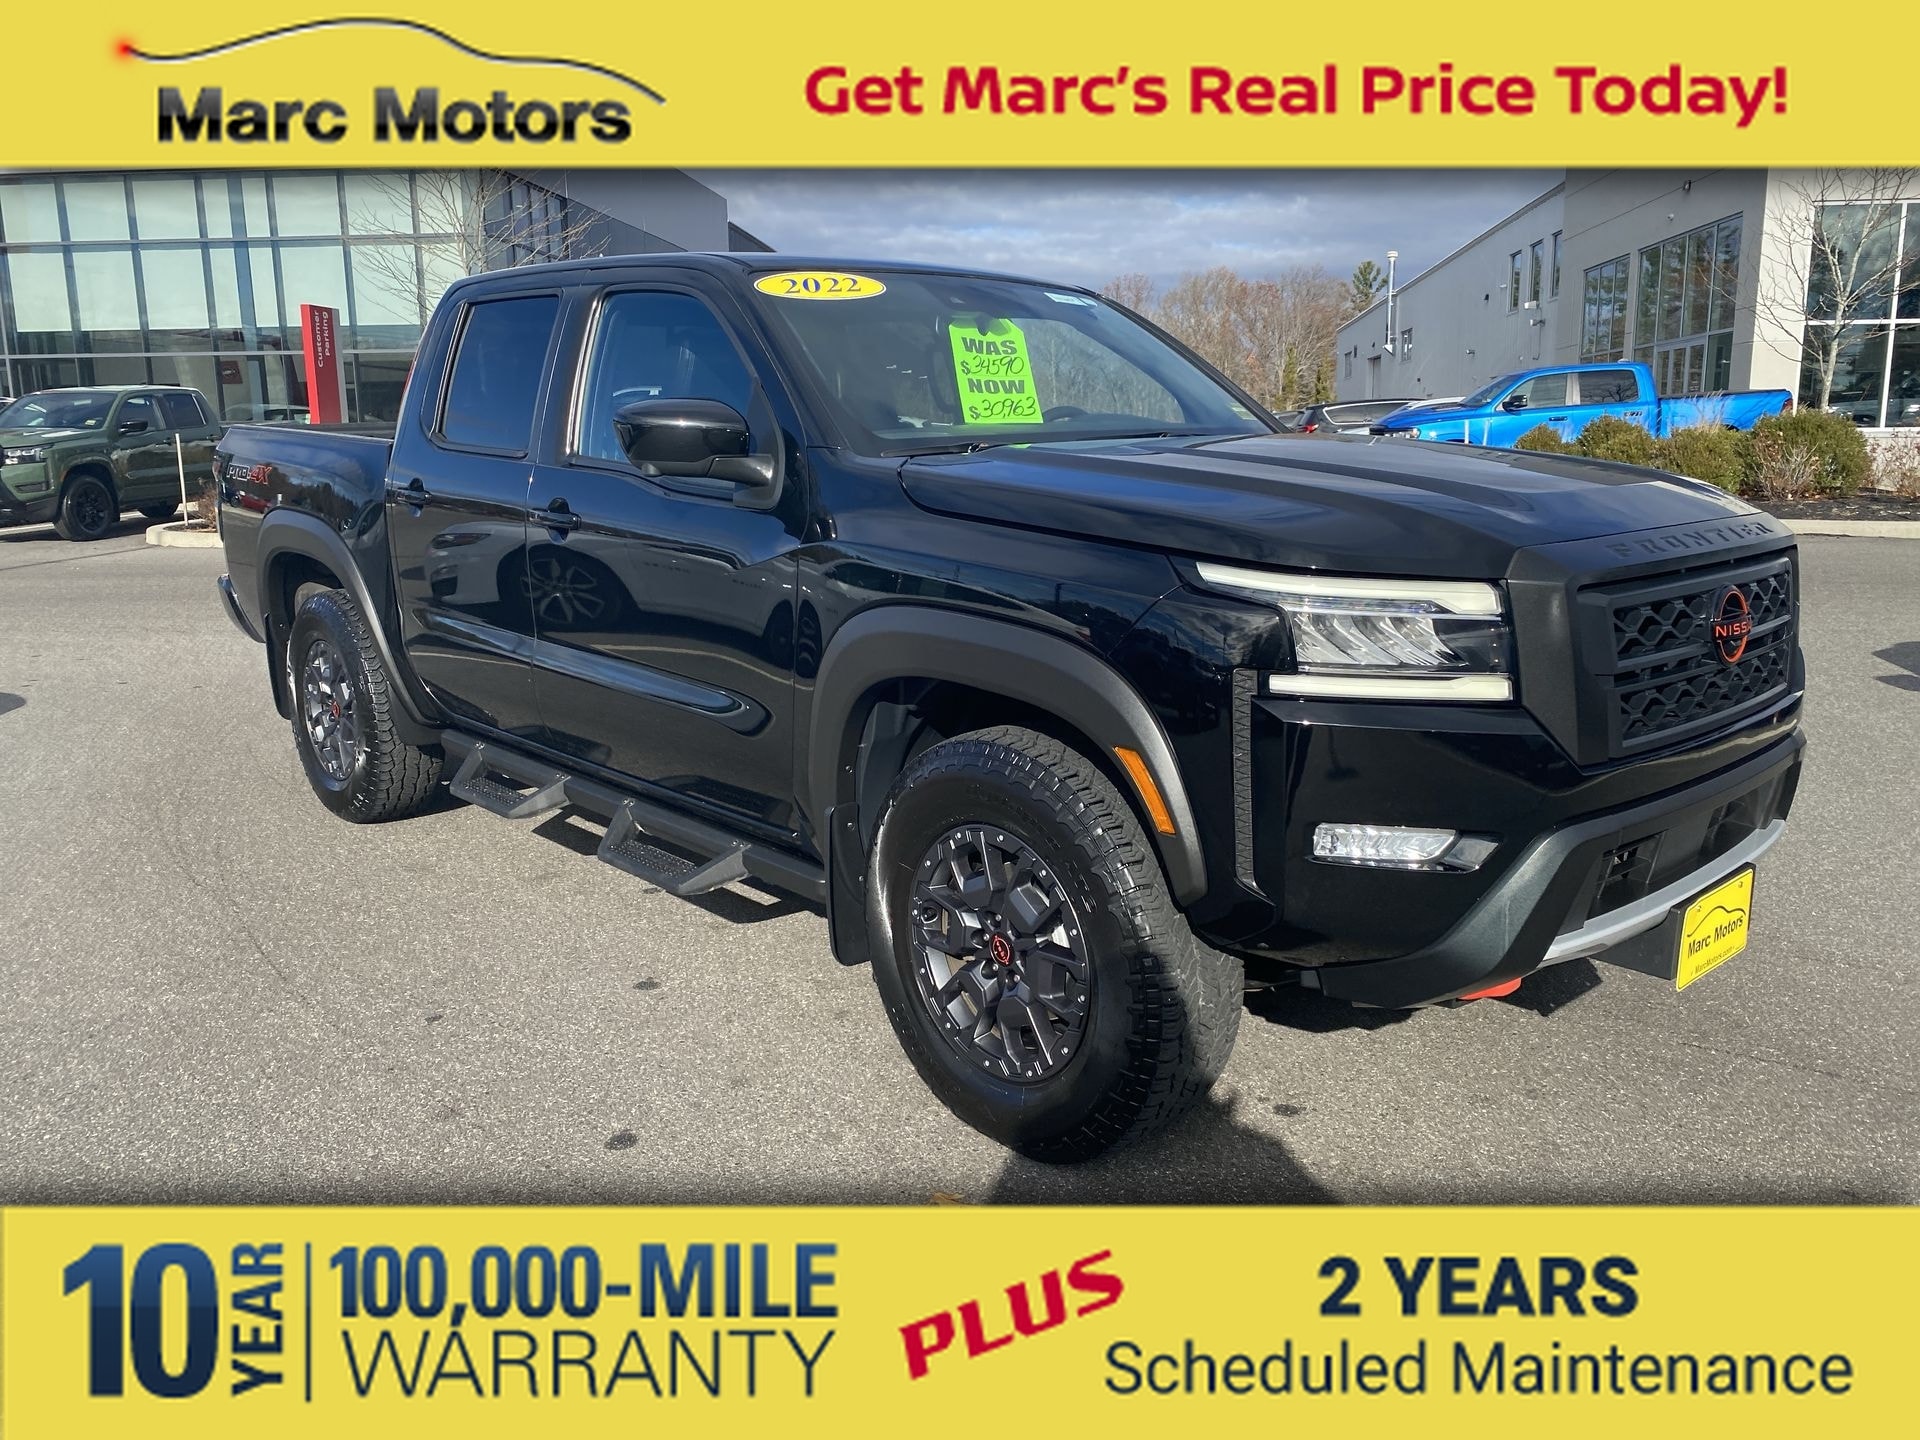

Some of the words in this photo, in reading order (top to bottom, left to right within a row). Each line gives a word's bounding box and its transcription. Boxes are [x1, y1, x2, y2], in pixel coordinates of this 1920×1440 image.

[780, 277, 861, 294] 2022
[314, 310, 324, 368] Customer
[322, 311, 331, 356] Parking
[961, 336, 1018, 355] WAS
[968, 378, 1025, 394] NOW
[968, 397, 1036, 420] $30,963
[1604, 521, 1774, 558] FRONTIER
[1715, 621, 1752, 638] NISS
[1687, 934, 1711, 959] Marc
[1713, 915, 1744, 943] Motors
